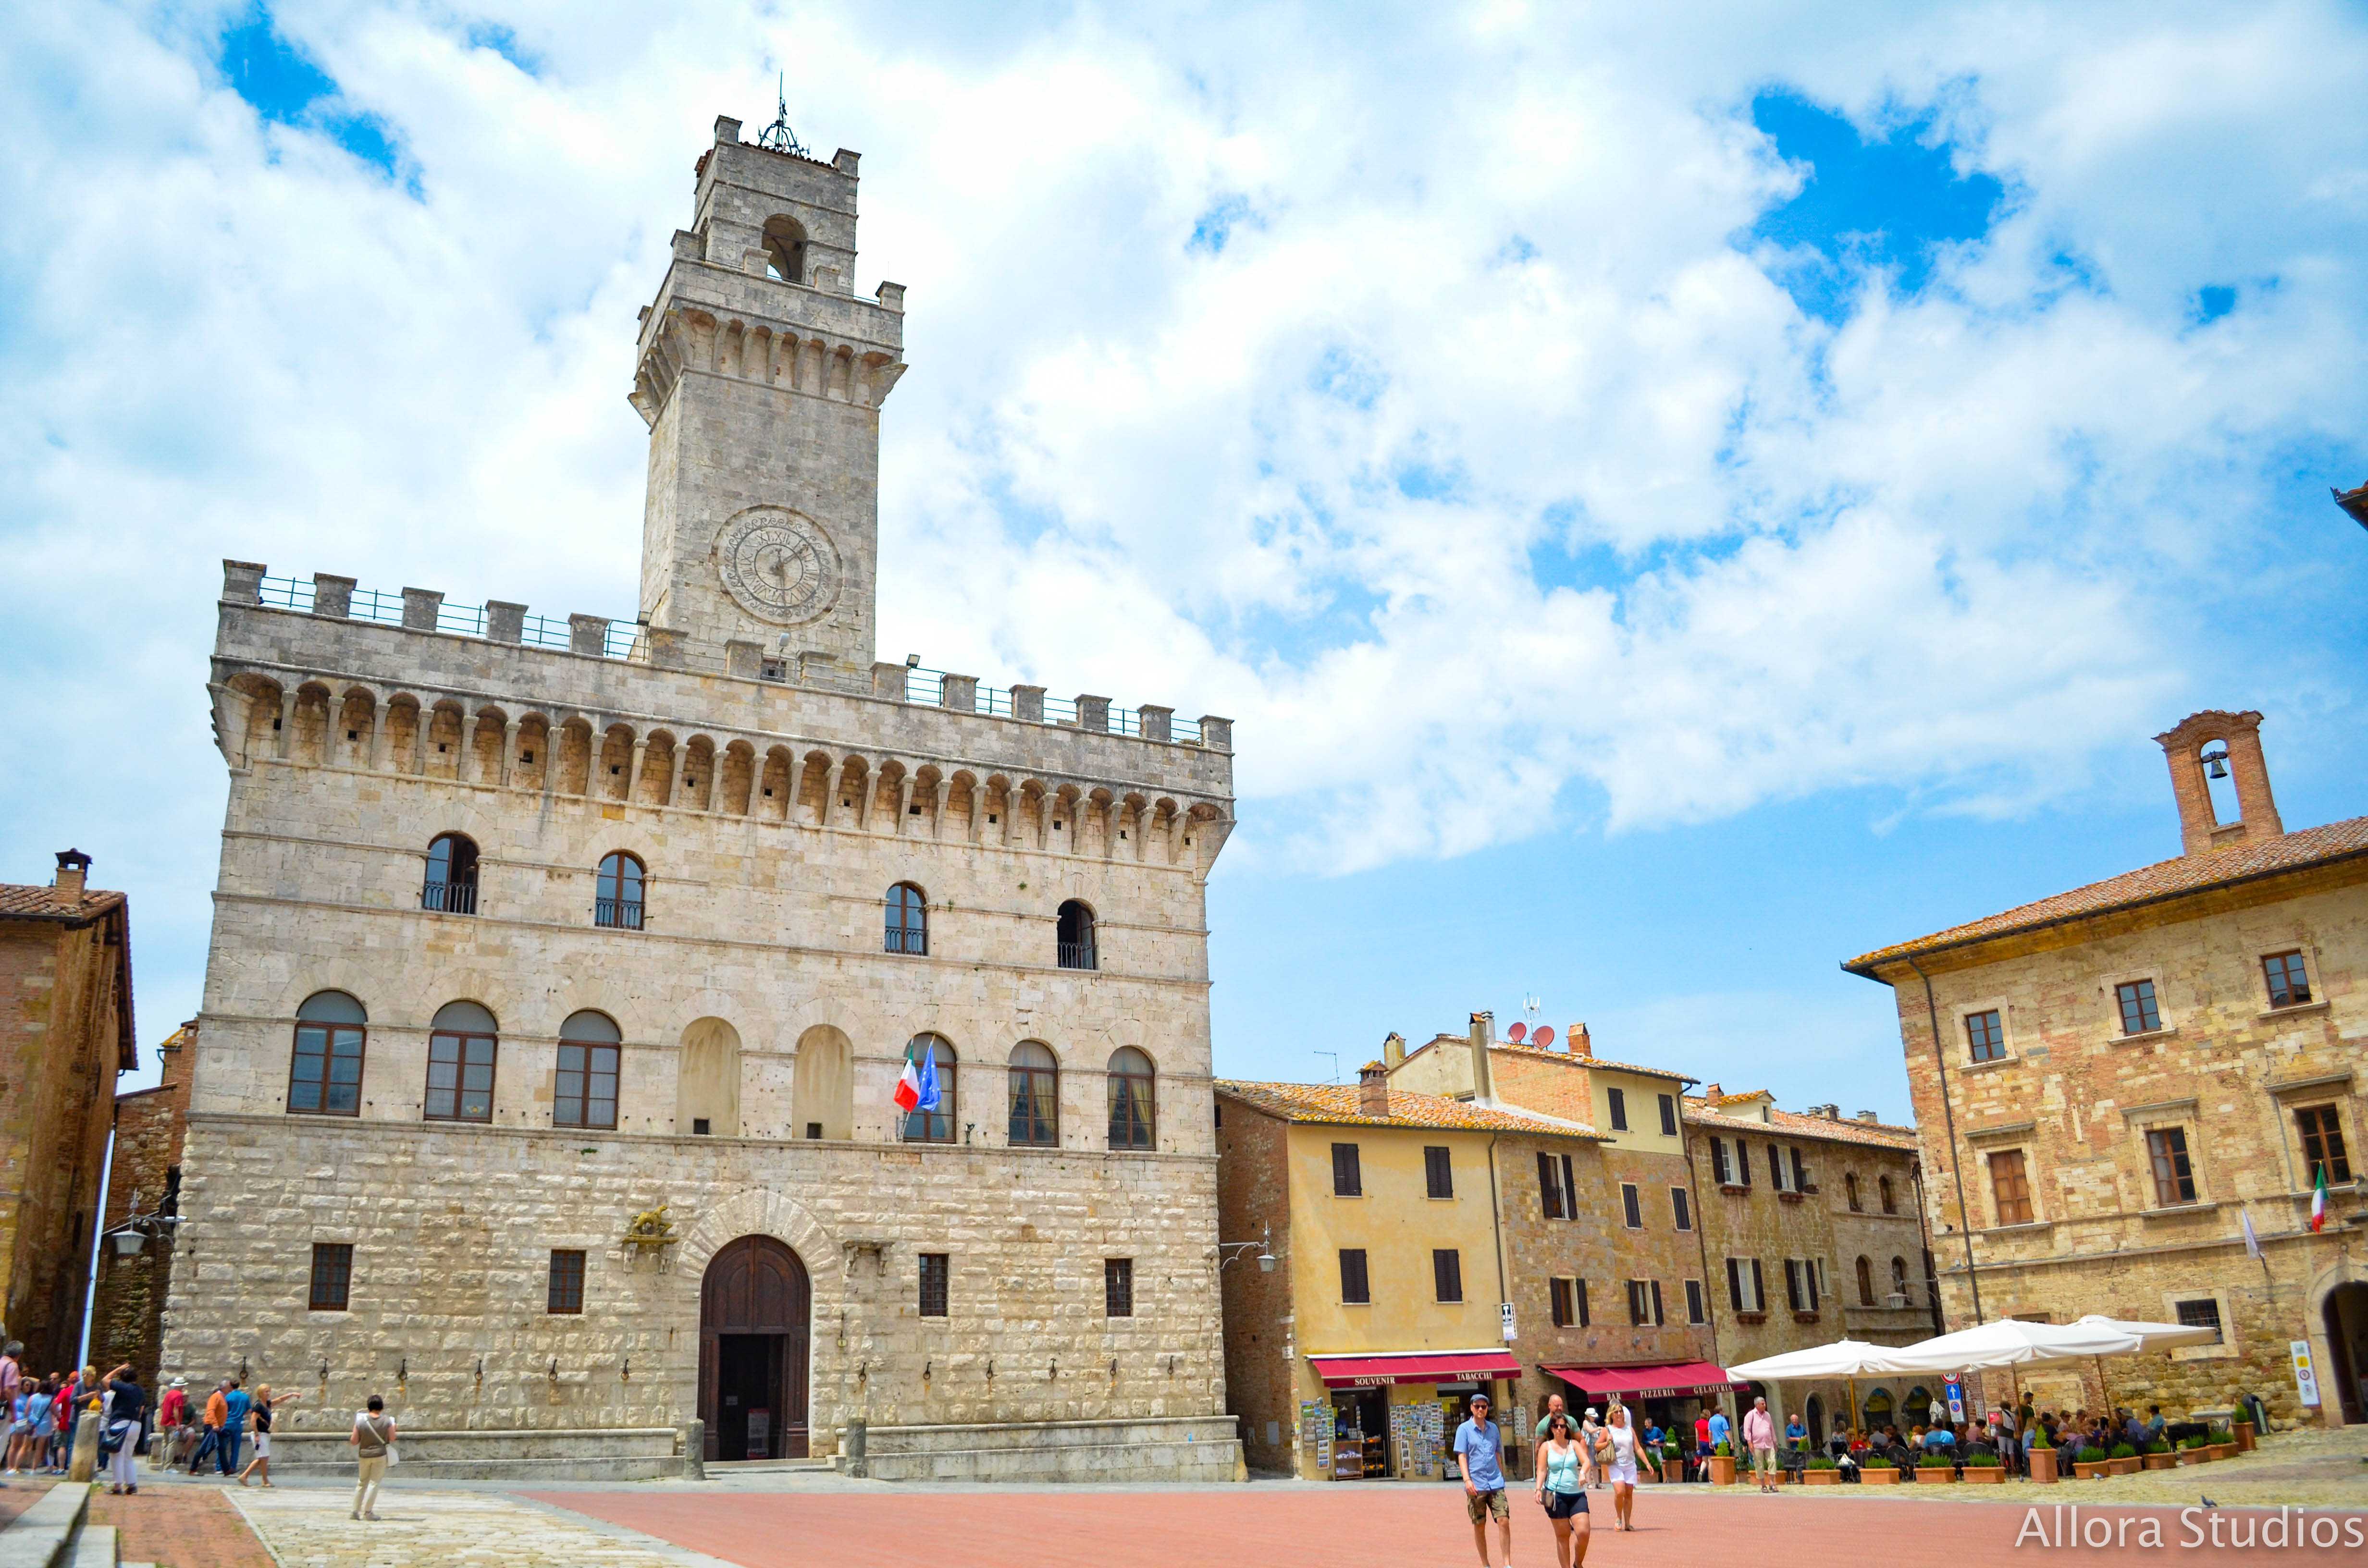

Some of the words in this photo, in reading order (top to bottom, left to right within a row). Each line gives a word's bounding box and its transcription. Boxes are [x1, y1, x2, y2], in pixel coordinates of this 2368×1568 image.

[1355, 1377, 1395, 1385] SOUVENIR
[1455, 1372, 1492, 1381] TABACCHI
[1606, 1392, 1622, 1401] BAR
[1640, 1388, 1676, 1398] PIZZERIA
[1693, 1384, 1733, 1394] GELATERIA
